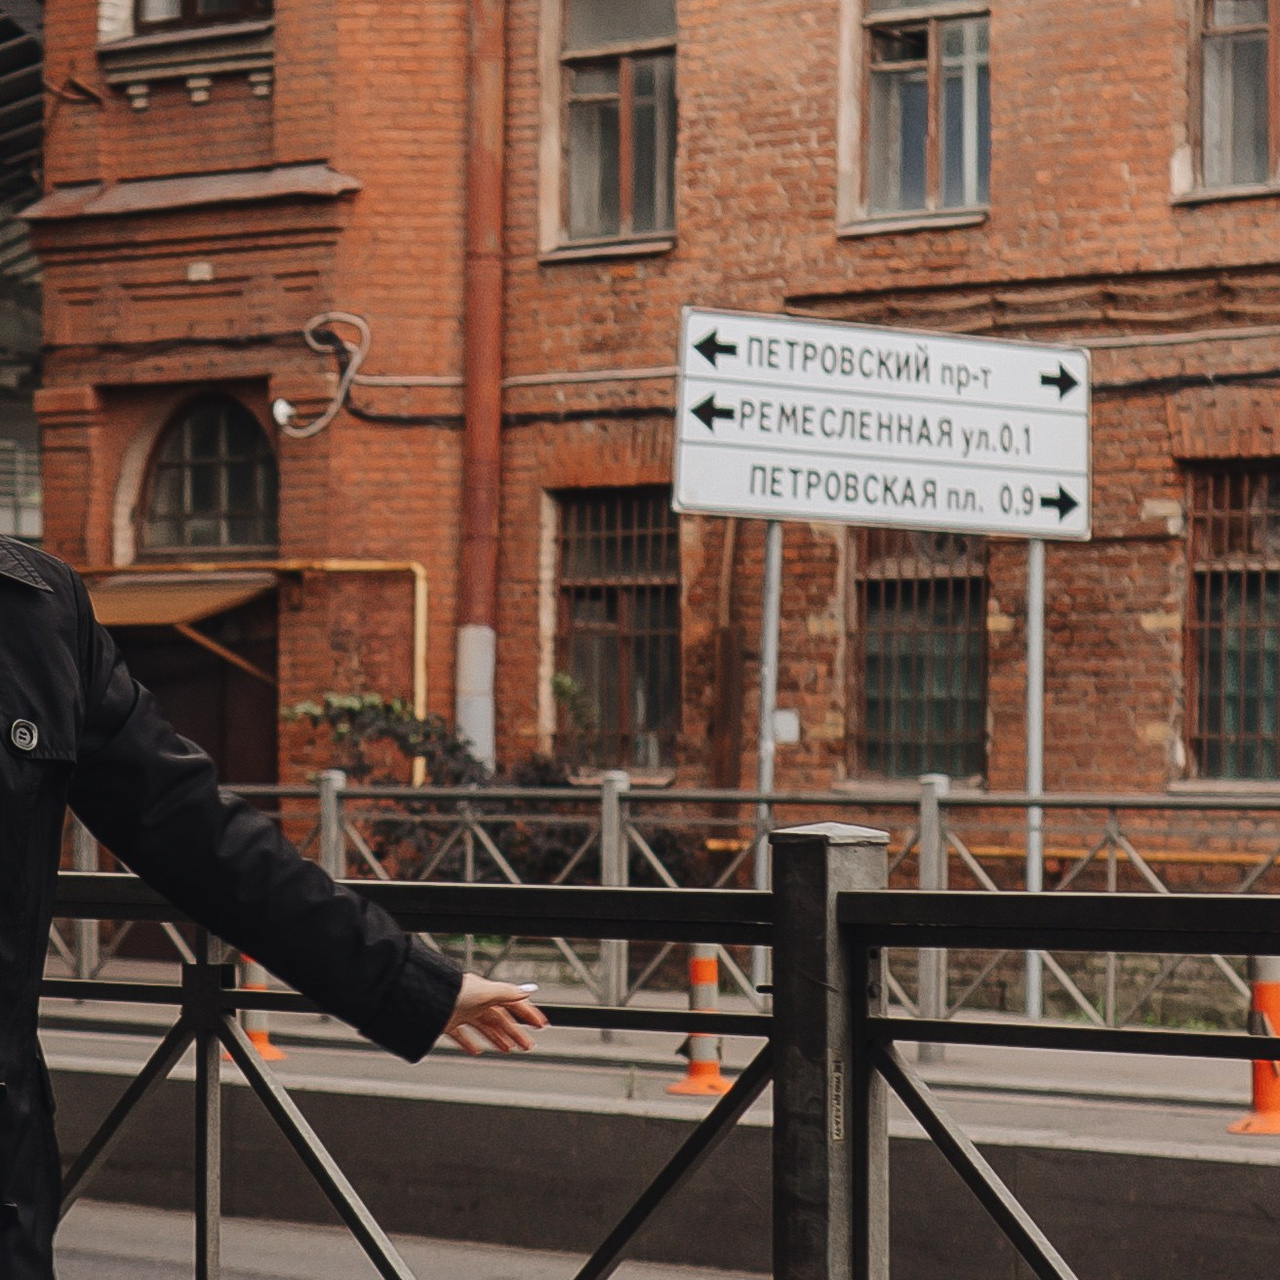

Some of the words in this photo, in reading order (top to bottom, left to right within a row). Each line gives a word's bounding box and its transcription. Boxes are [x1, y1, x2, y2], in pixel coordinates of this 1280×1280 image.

[746, 335, 931, 383] ПЕТРОВСКИЙ
[940, 363, 992, 394] пр-т
[738, 399, 953, 448] РЕМЕСЛЕННАЯ
[749, 463, 938, 508] ПЕТРОВСКАЯ
[946, 488, 984, 514] пл.
